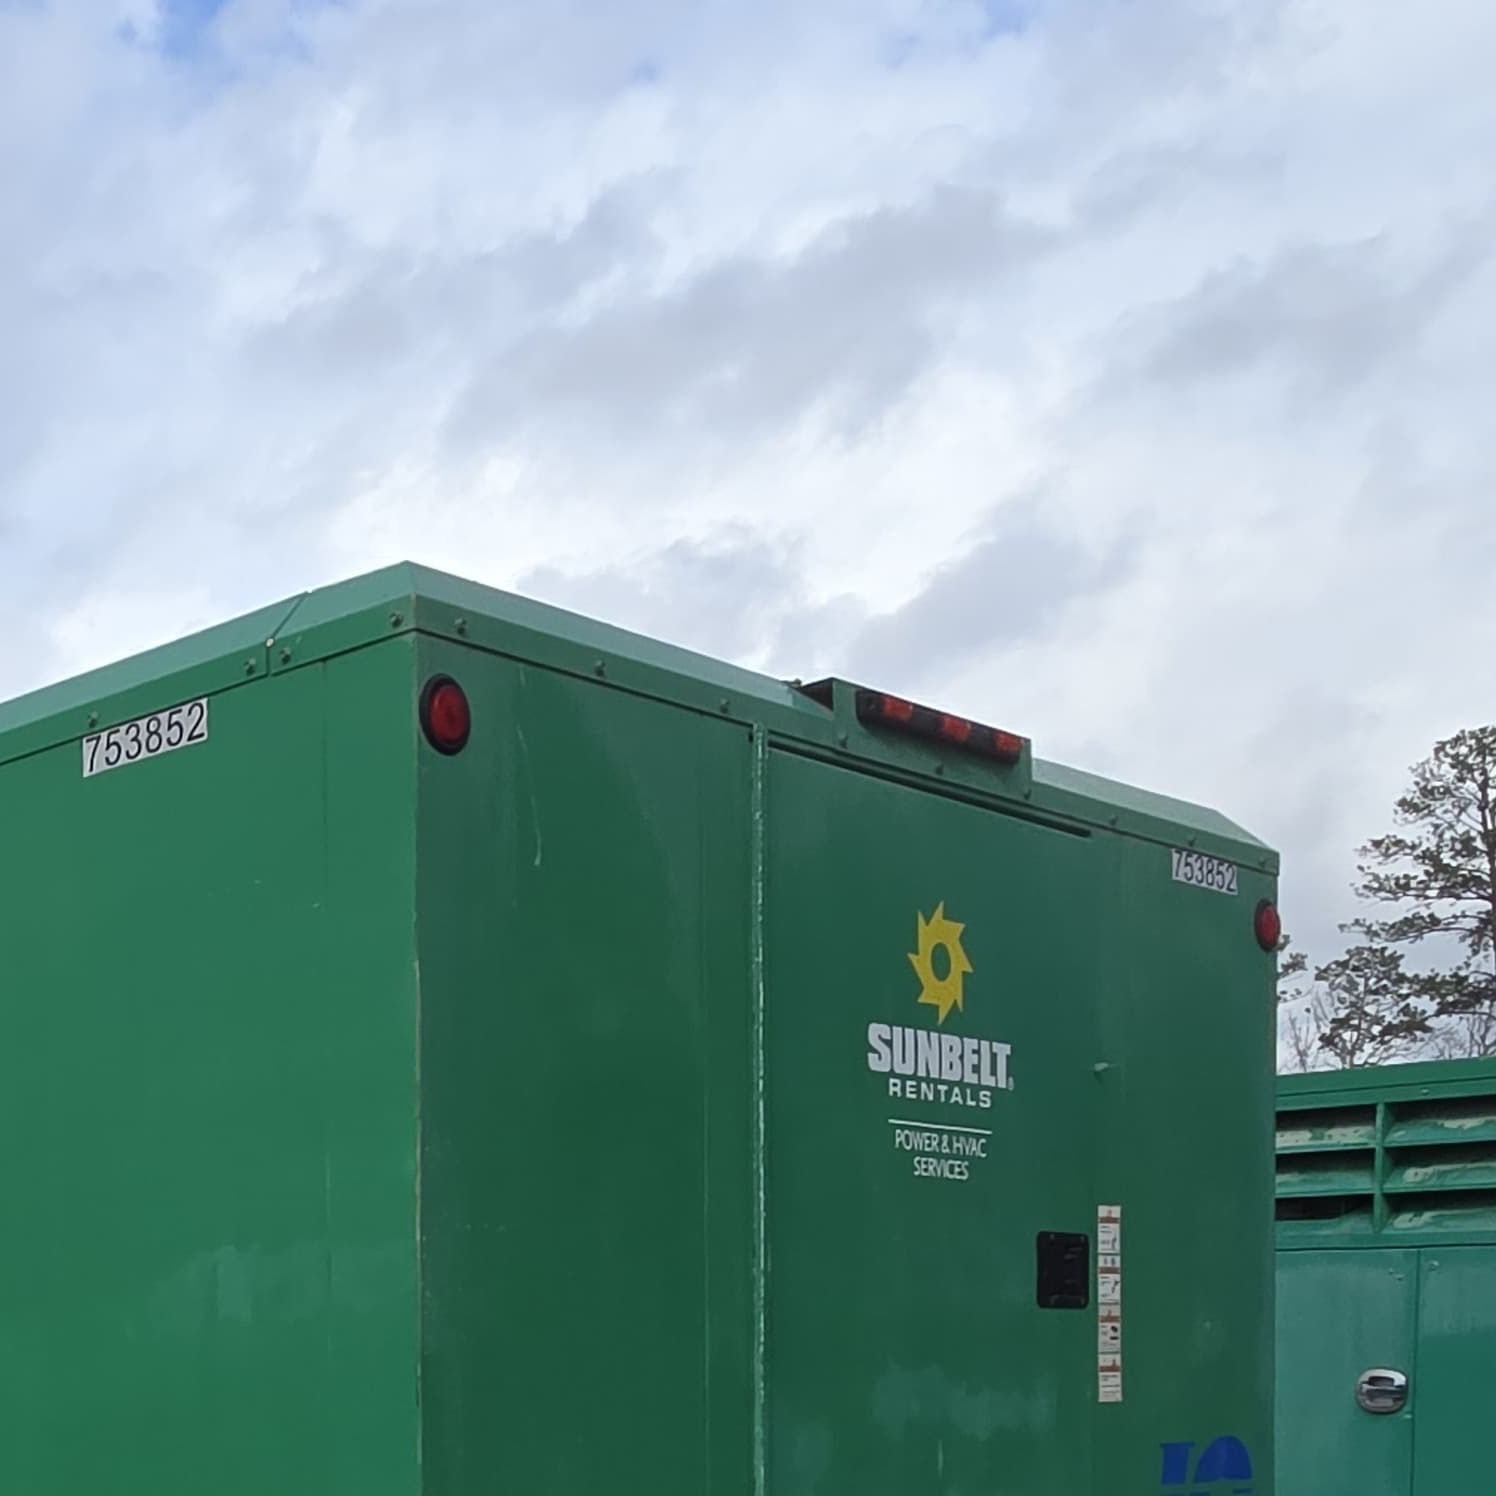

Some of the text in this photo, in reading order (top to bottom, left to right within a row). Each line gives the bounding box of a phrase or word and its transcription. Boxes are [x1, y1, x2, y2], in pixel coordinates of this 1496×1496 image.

[85, 702, 206, 773] 753852
[1173, 849, 1236, 892] 753852
[867, 1022, 1011, 1088] SUNBELT
[888, 1077, 992, 1108] RENTALS
[895, 1129, 987, 1158] POWER & HVAC
[913, 1156, 969, 1180] SERVICES
